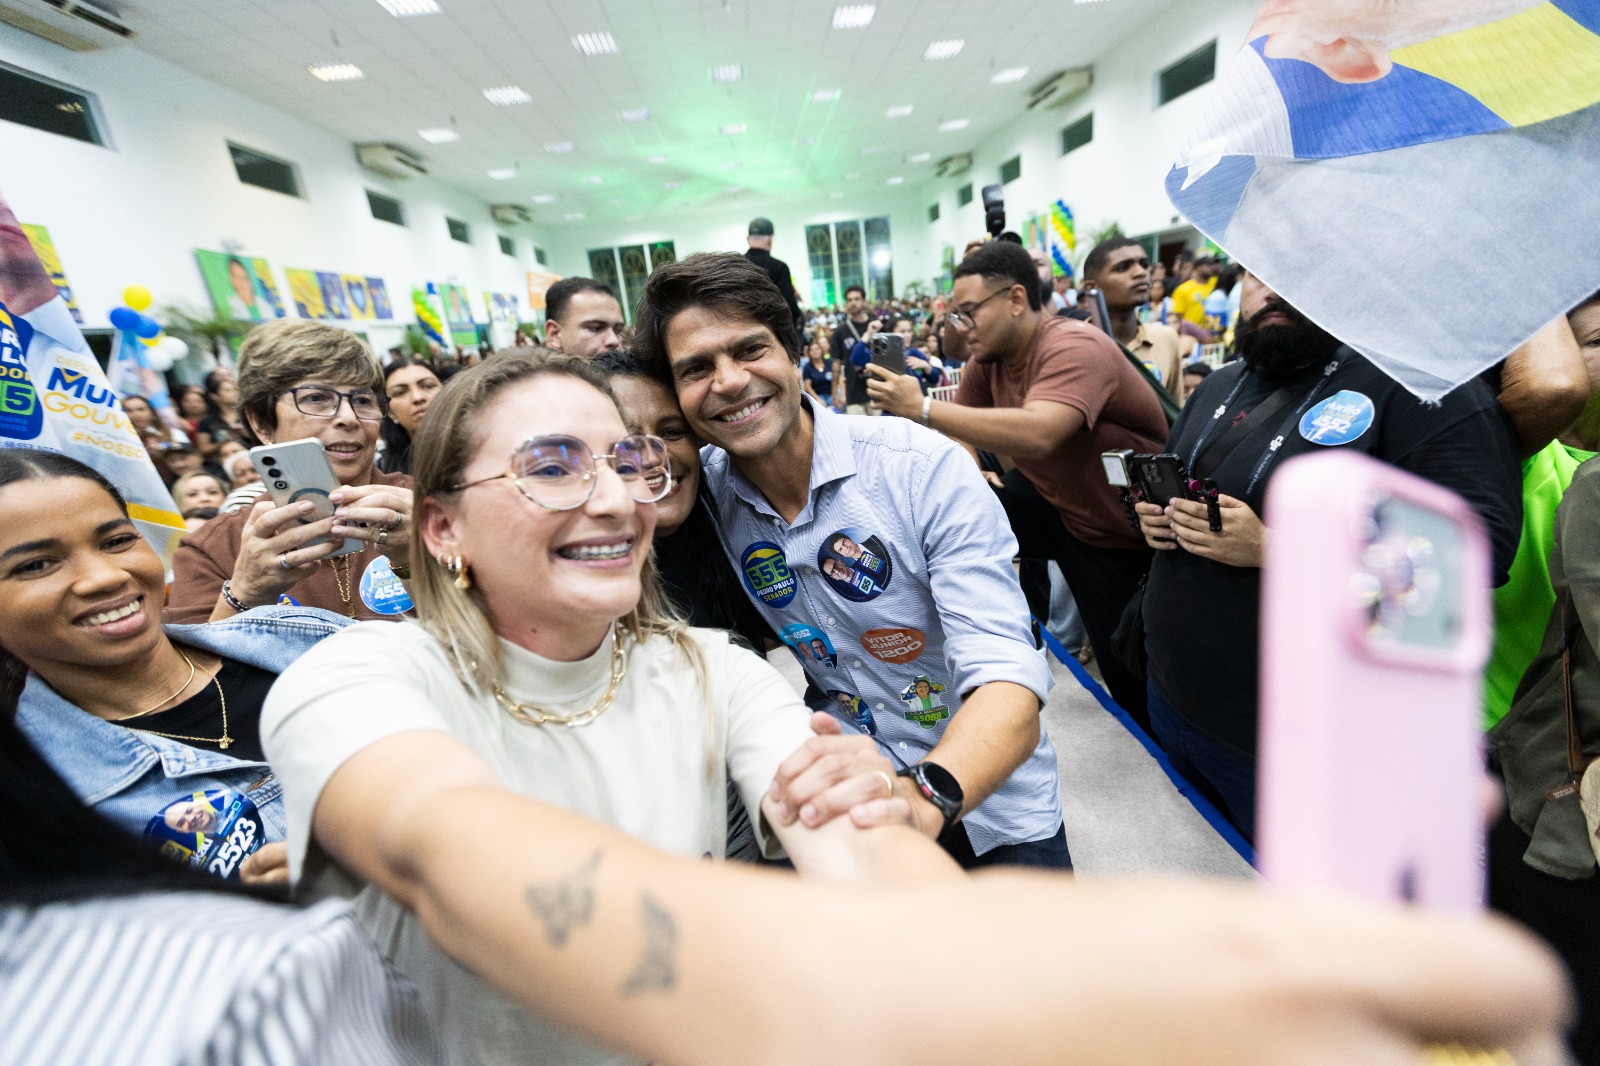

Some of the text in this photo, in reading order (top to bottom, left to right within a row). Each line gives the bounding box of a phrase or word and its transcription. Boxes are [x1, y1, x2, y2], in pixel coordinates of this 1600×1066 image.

[747, 556, 790, 587] 555
[374, 582, 407, 600] 455
[756, 577, 795, 597] PEDRO PAULO
[763, 586, 794, 602] SENADOR
[864, 632, 906, 644] VITOR
[870, 635, 913, 649] JUNIOR
[873, 640, 923, 659] 1200
[208, 817, 257, 879] 2523
